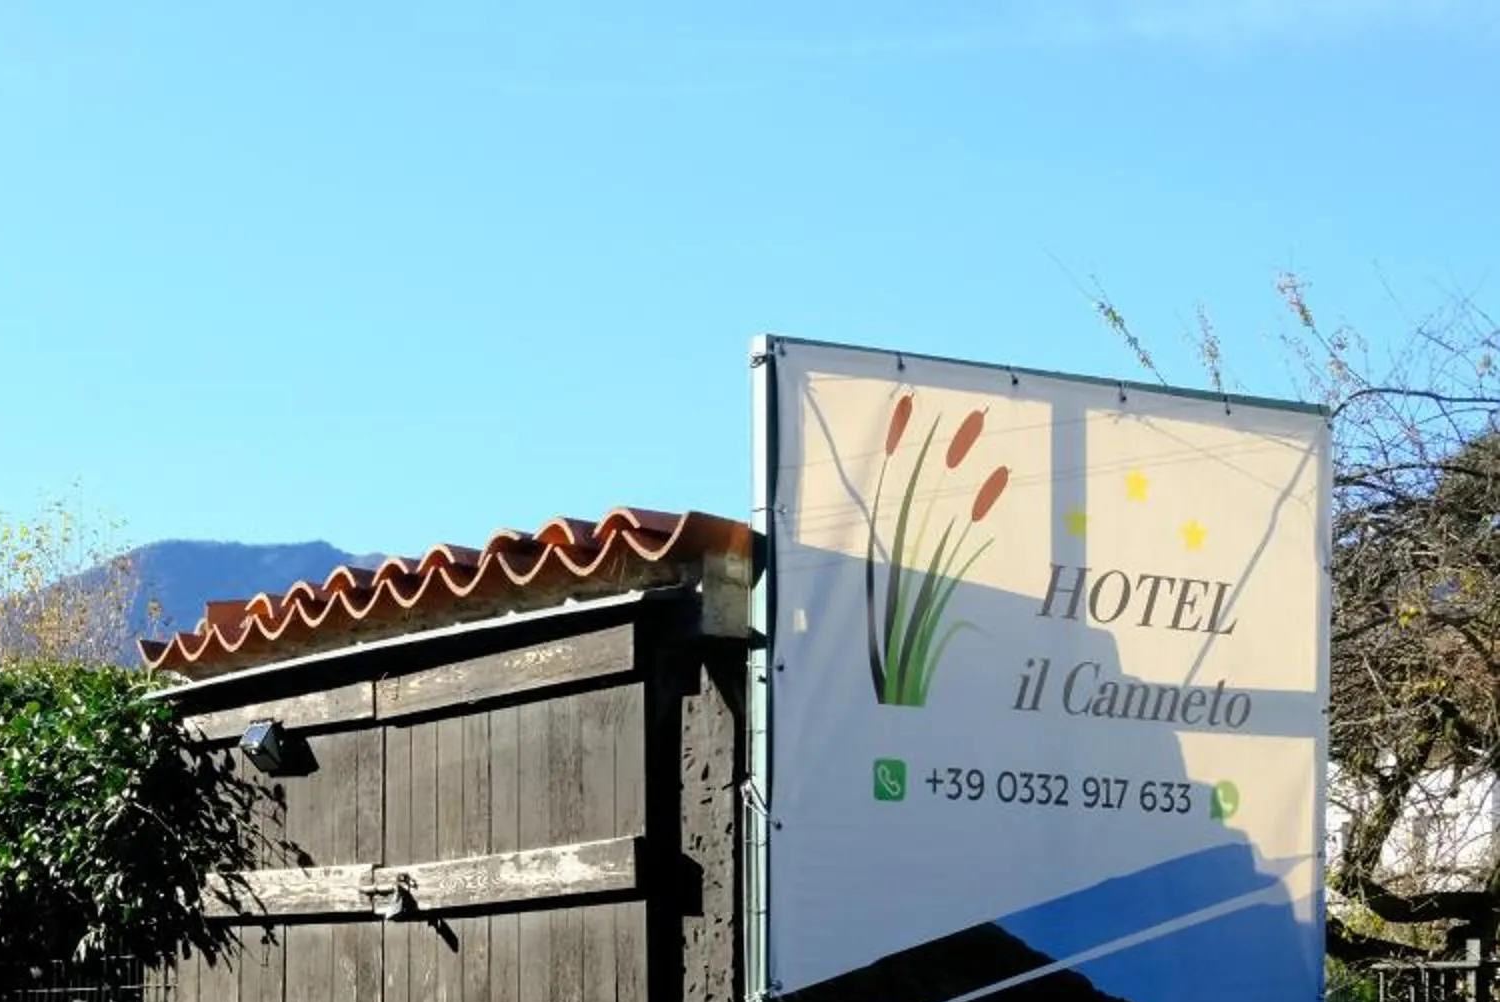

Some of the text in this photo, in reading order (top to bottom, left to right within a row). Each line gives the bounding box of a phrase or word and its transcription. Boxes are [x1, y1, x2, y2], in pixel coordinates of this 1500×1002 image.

[1036, 563, 1238, 635] HOTEL
[1012, 658, 1252, 729] il Canneto
[925, 767, 1191, 814] +39 0332 917 633
